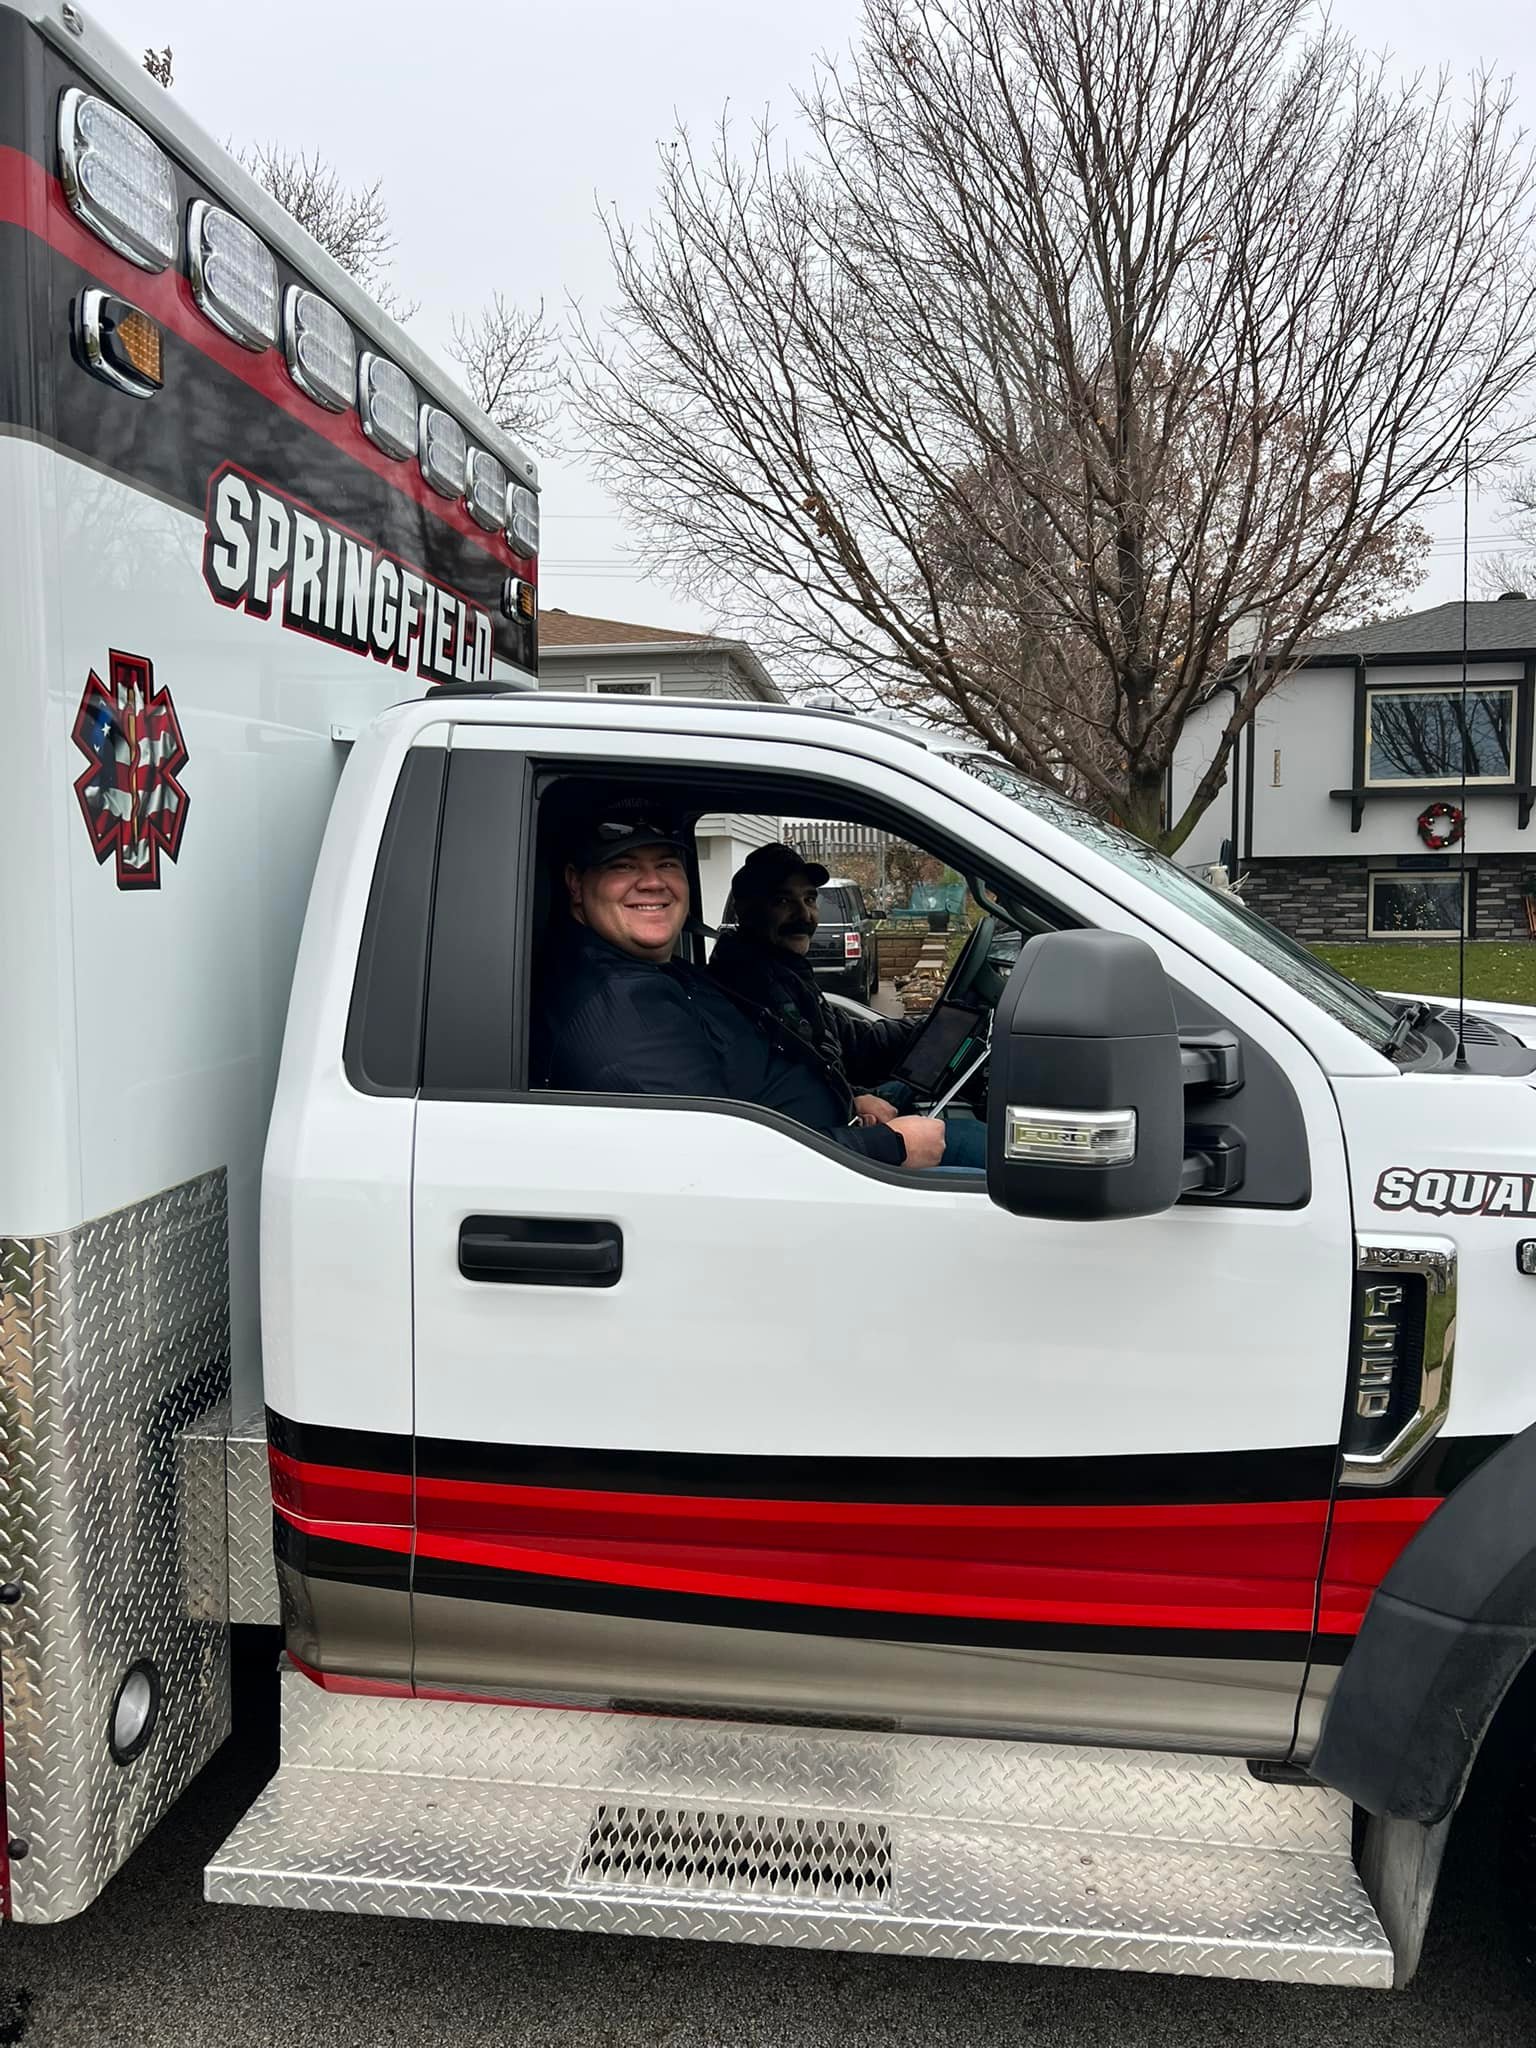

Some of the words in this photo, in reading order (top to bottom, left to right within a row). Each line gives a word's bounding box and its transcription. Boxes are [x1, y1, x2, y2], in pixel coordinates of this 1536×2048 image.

[205, 463, 494, 684] SPRINGFIELD
[1018, 1126, 1088, 1145] FORD
[1376, 1168, 1536, 1216] SQUA
[1380, 1249, 1425, 1264] XLT
[1356, 1284, 1403, 1419] F550
